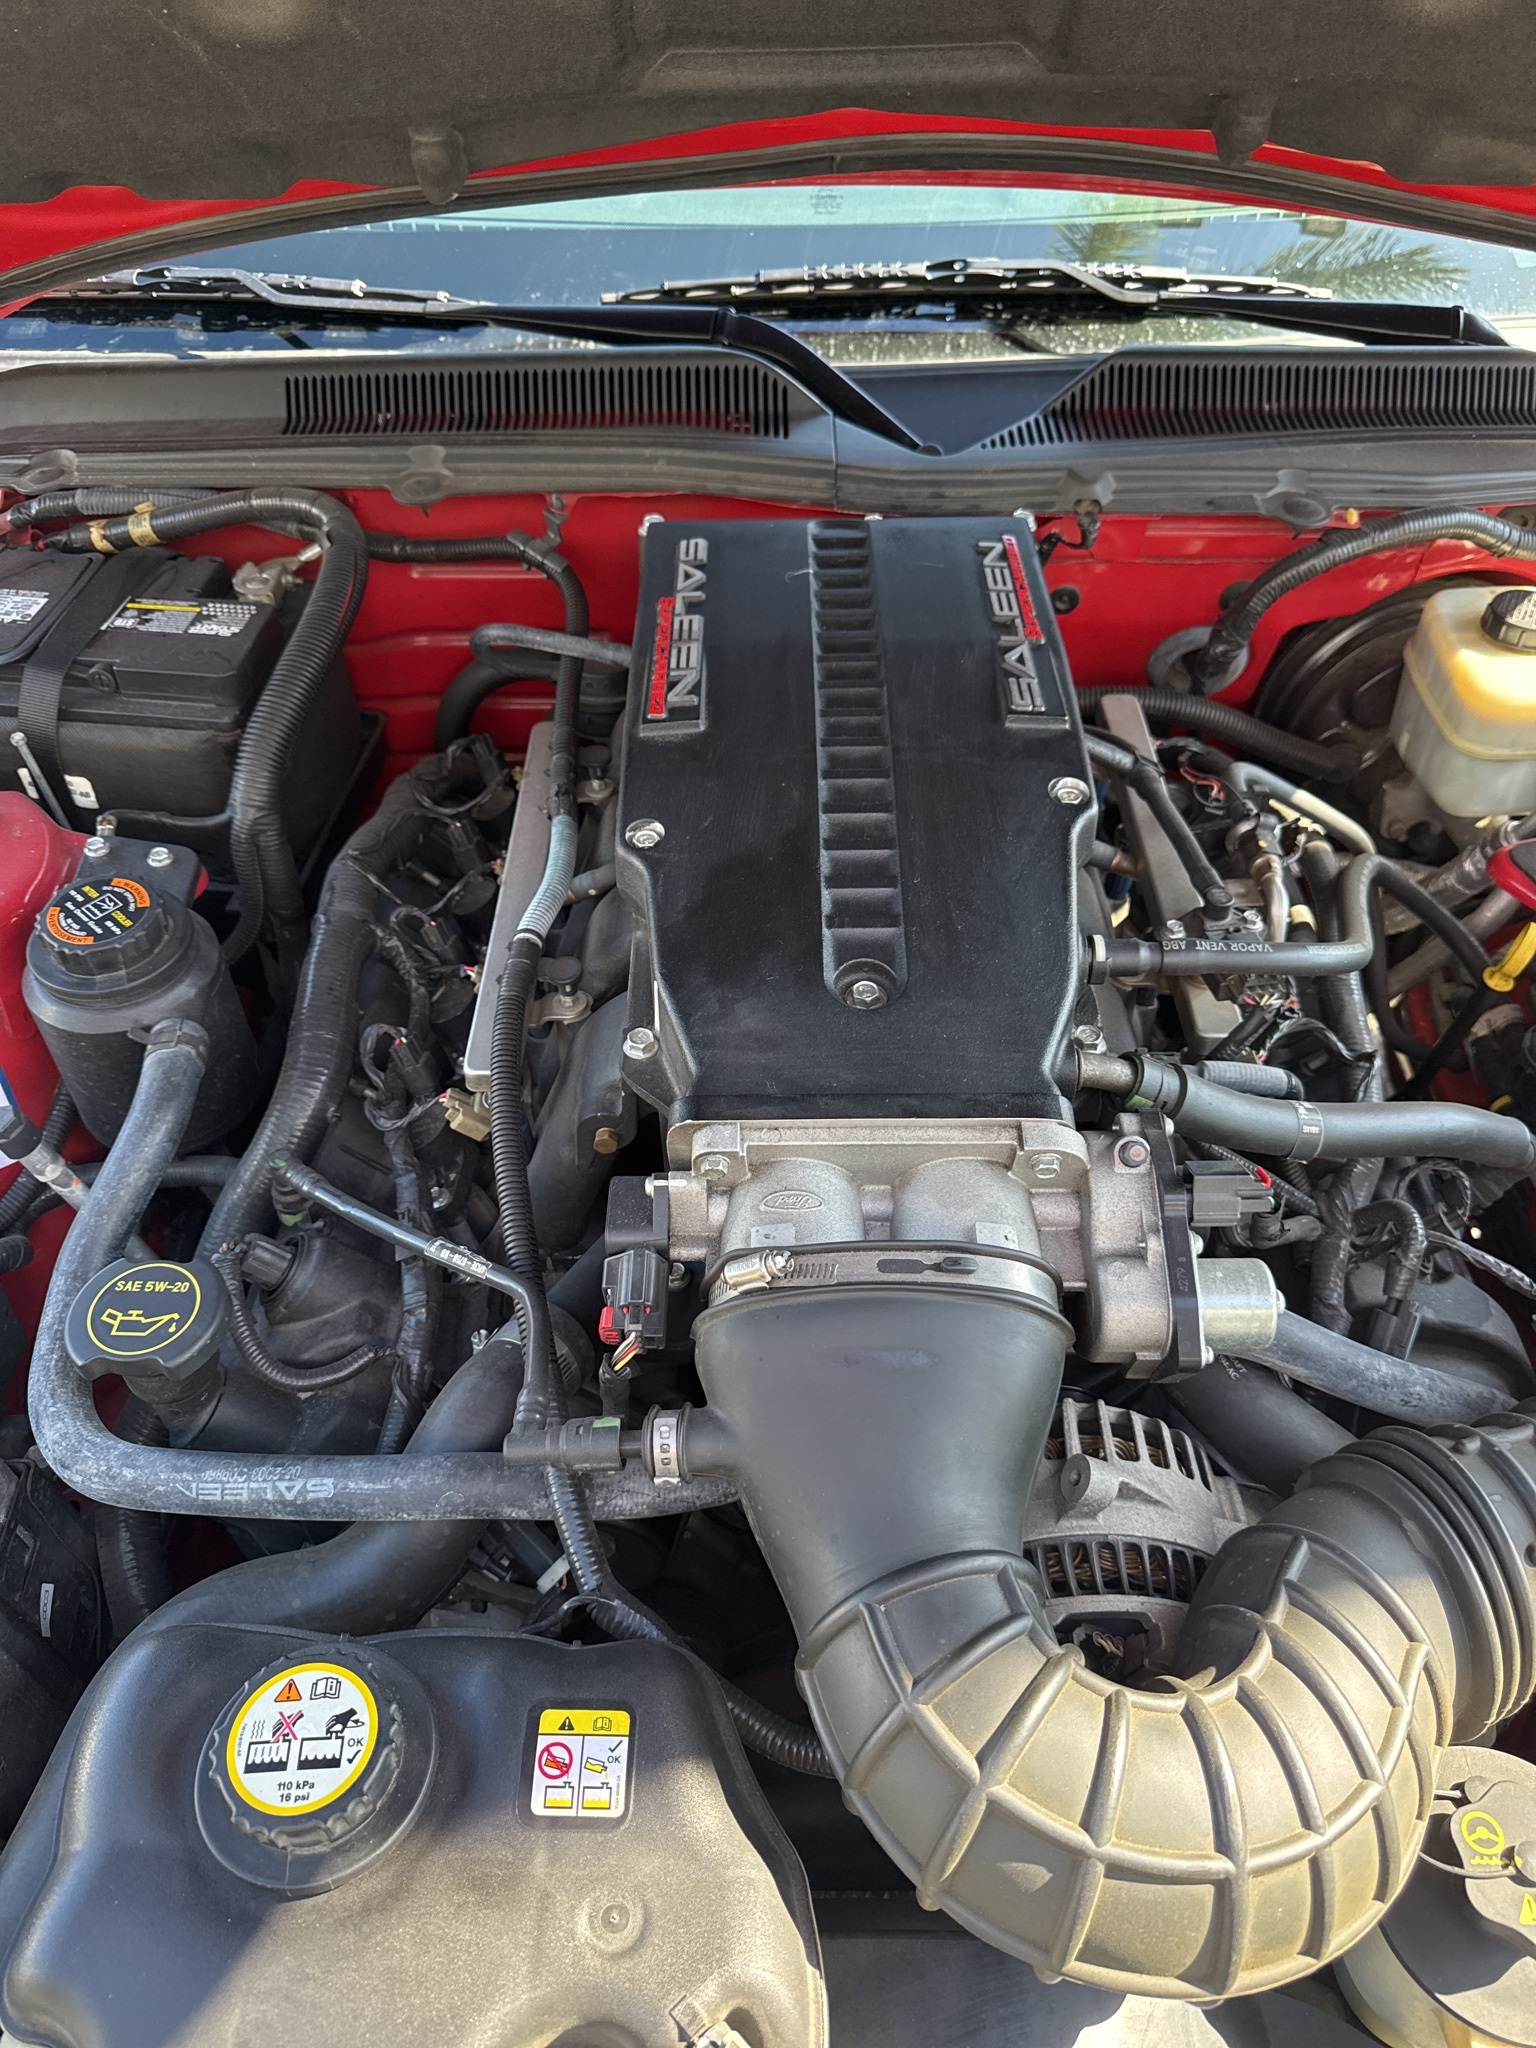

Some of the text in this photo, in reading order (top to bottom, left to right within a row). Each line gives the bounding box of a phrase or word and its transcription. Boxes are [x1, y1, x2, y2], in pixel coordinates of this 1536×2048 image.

[1002, 534, 1044, 644] SUPERCHARGED
[667, 537, 708, 707] SALEEN
[977, 540, 1047, 713] SALEEN
[646, 597, 676, 719] SUPERCHARGED
[123, 882, 146, 905] WARNING
[49, 913, 88, 943] AVERTISSEMENT
[1162, 939, 1273, 953] VAPOR VENT ABG
[774, 1194, 812, 1209] Ford
[115, 1280, 190, 1293] SAE 5W-20
[347, 1737, 364, 1748] OK
[607, 1755, 621, 1764] OK
[276, 1780, 315, 1791] 110 kPa
[279, 1792, 310, 1804] 16 psi
